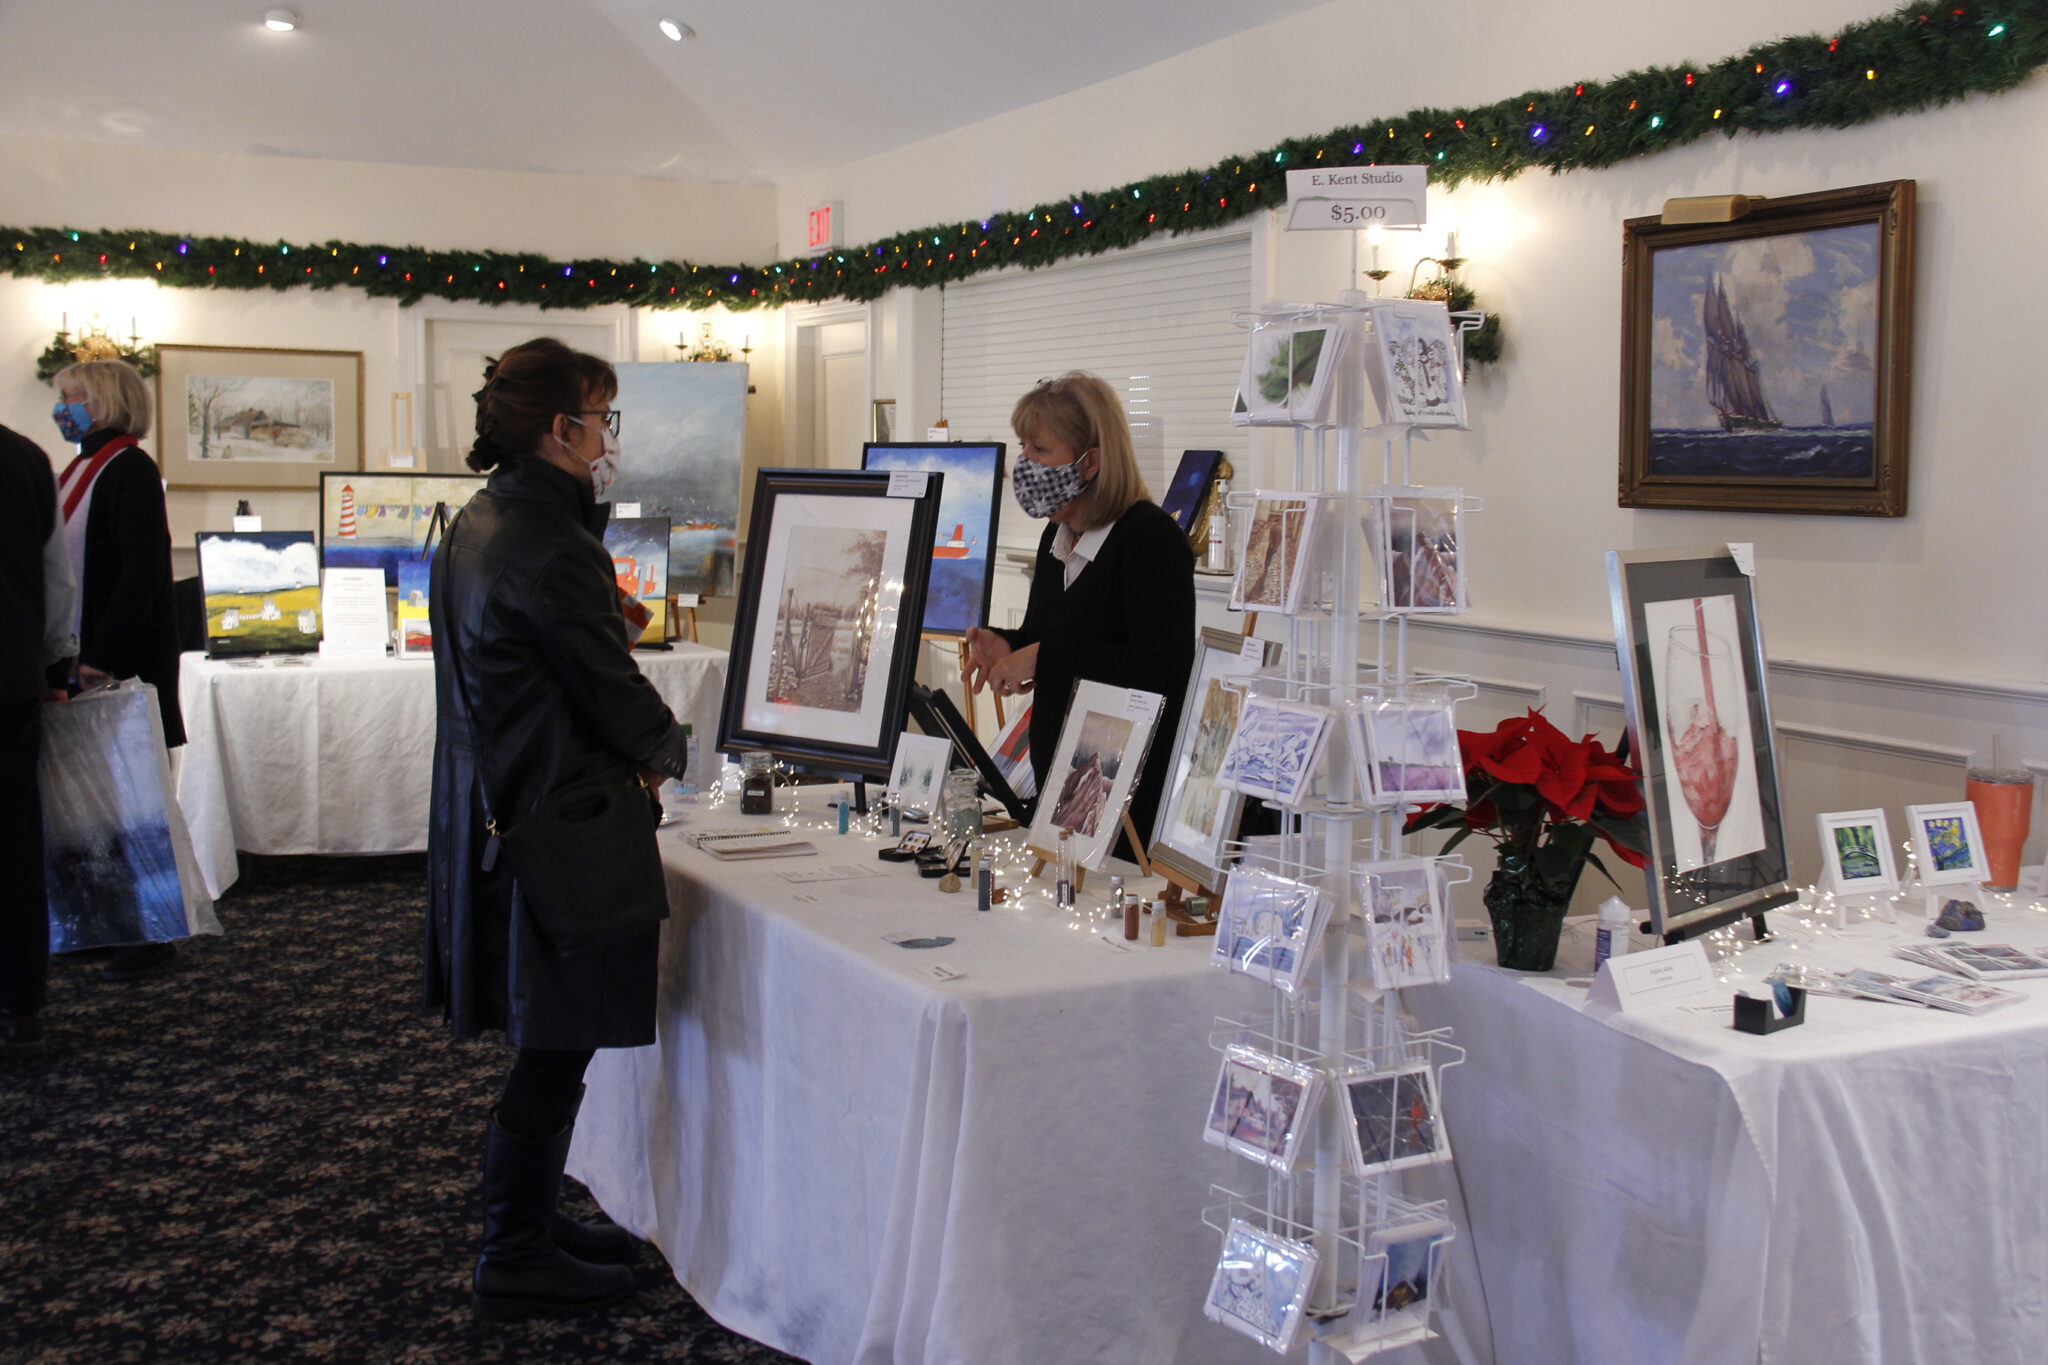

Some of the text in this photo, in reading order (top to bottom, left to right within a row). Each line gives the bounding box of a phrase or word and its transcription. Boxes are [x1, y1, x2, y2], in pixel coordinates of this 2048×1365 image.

[1312, 171, 1403, 186] E. Kent Studio
[1331, 203, 1386, 224] $5.00
[808, 206, 831, 247] EXIT
